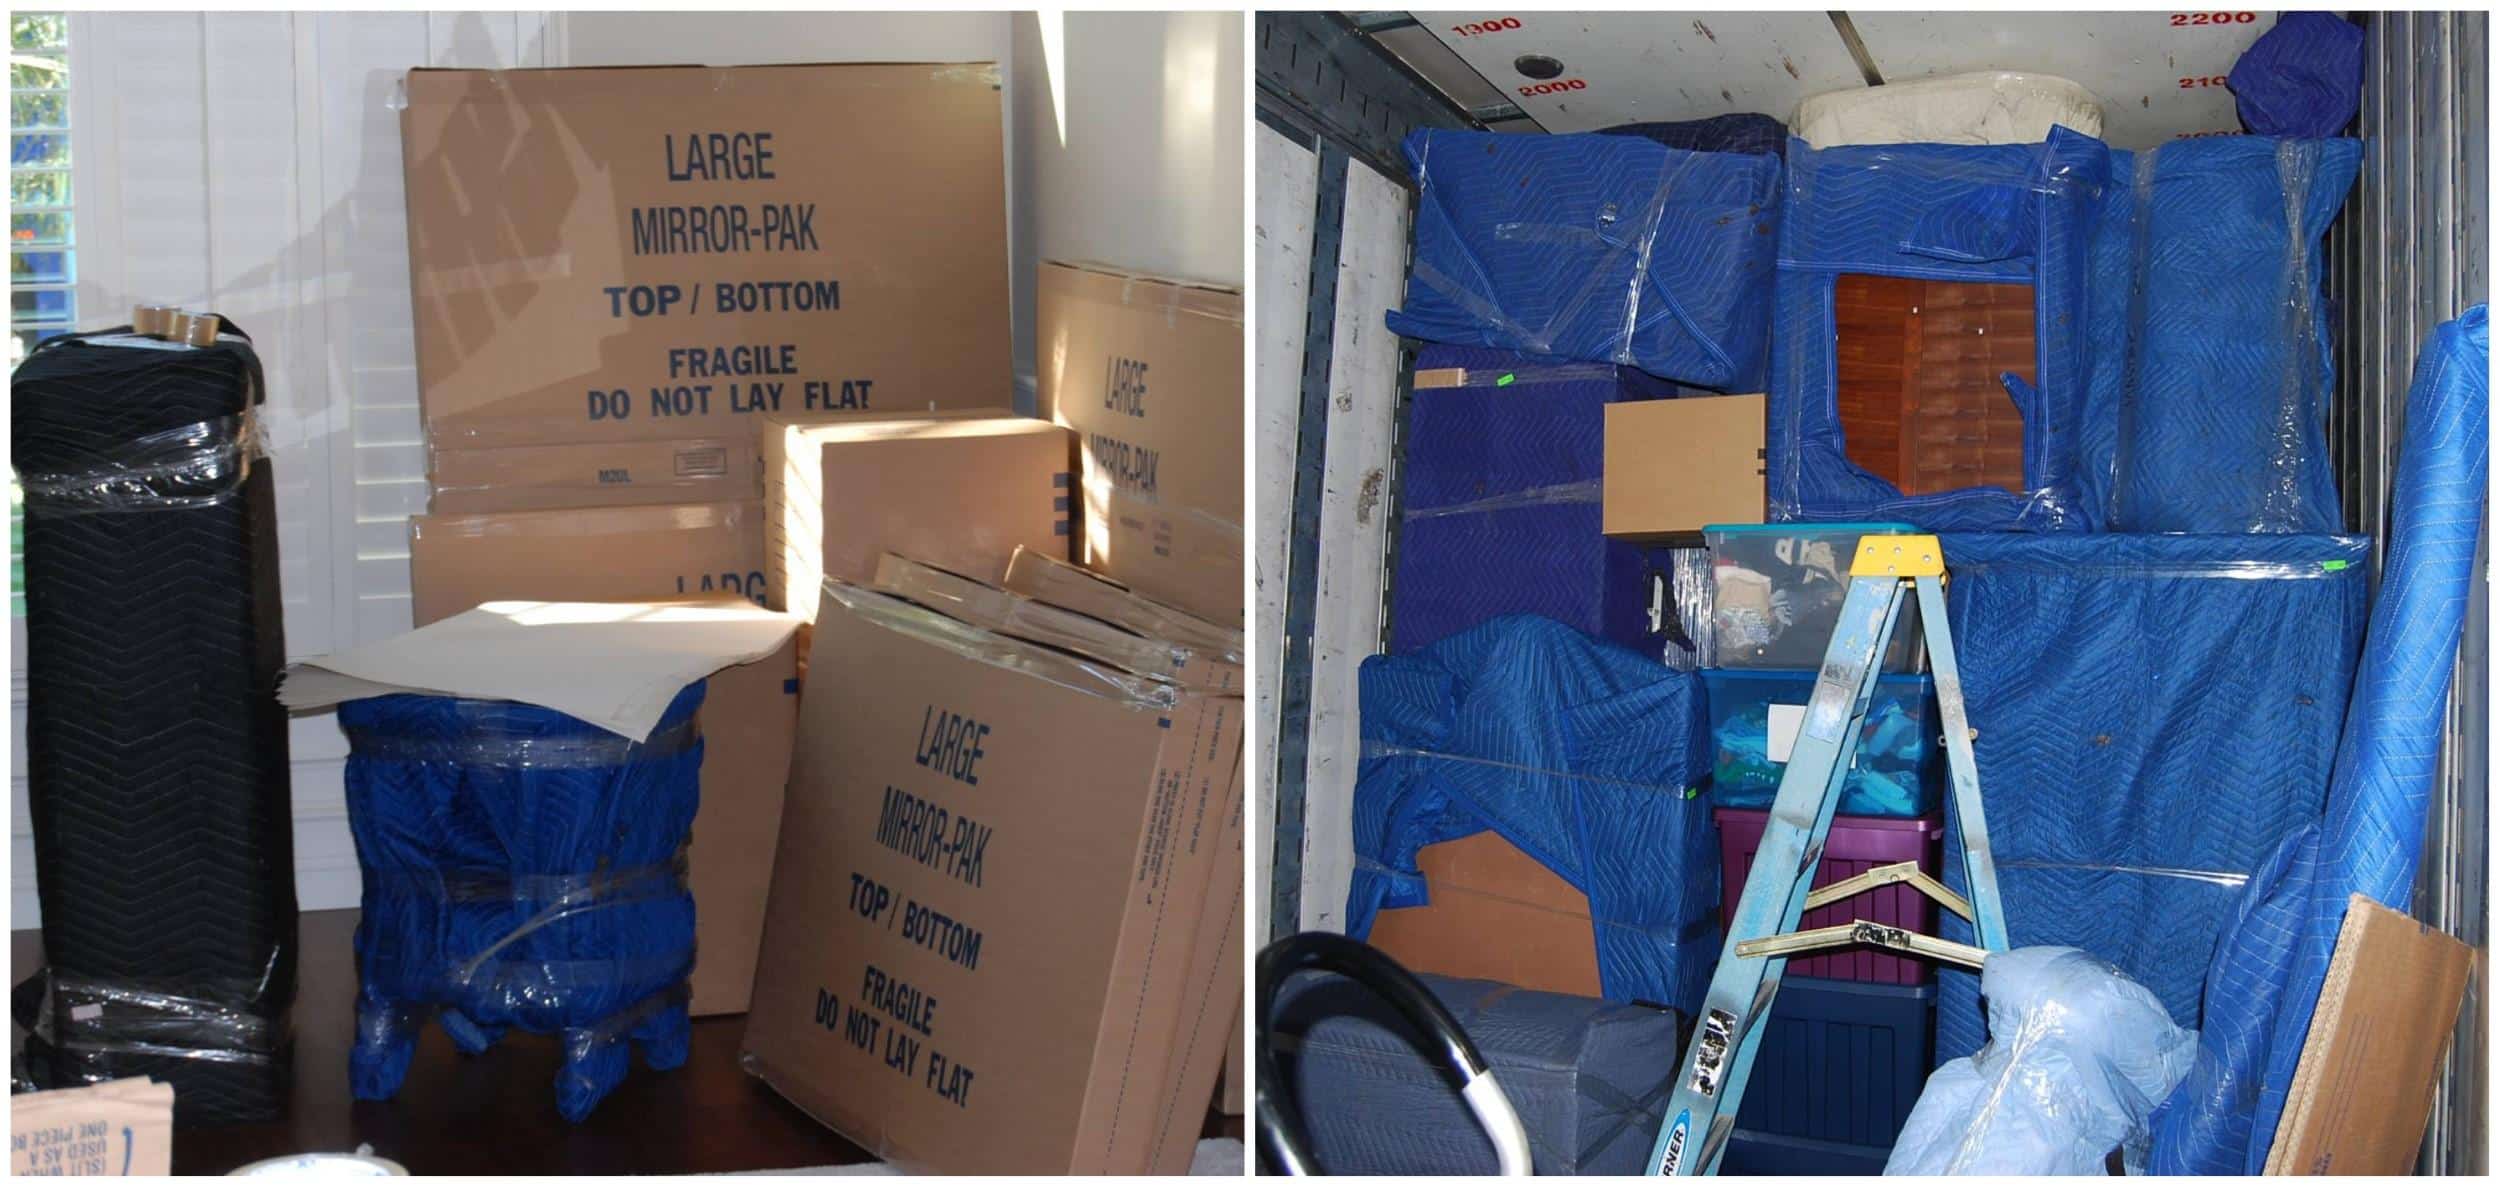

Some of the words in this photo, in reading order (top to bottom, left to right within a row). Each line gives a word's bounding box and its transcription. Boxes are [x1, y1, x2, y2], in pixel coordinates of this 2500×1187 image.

[2170, 12, 2256, 26] 2200
[1518, 79, 1587, 97] 2000
[2178, 75, 2228, 88] 210
[665, 132, 776, 181] LARGE
[632, 204, 819, 255] MIRROR-PAK
[603, 285, 682, 317] TOP
[690, 283, 700, 315] /
[716, 280, 840, 312] BOTTOM
[669, 344, 798, 378] FRAGILE
[587, 389, 631, 420] DO
[651, 386, 712, 416] NOT
[730, 383, 784, 414] LAY
[804, 380, 873, 410] FLAT
[1104, 355, 1148, 418] LARGE
[915, 705, 991, 786] LARGE
[875, 784, 993, 888] MIRROR-PAK
[849, 872, 889, 922] TOP
[888, 893, 901, 931] /
[903, 900, 982, 971] BOTTOM
[862, 964, 936, 1037] FRAGILE
[815, 987, 839, 1031] DO
[845, 1004, 881, 1055] NOT
[885, 1027, 921, 1078] LAY
[926, 1050, 974, 1109] FLAT
[32, 1127, 73, 1146] PIECE
[80, 1121, 107, 1136] ONE
[29, 1151, 39, 1167] A
[44, 1147, 62, 1163] AS
[68, 1140, 107, 1160] USED
